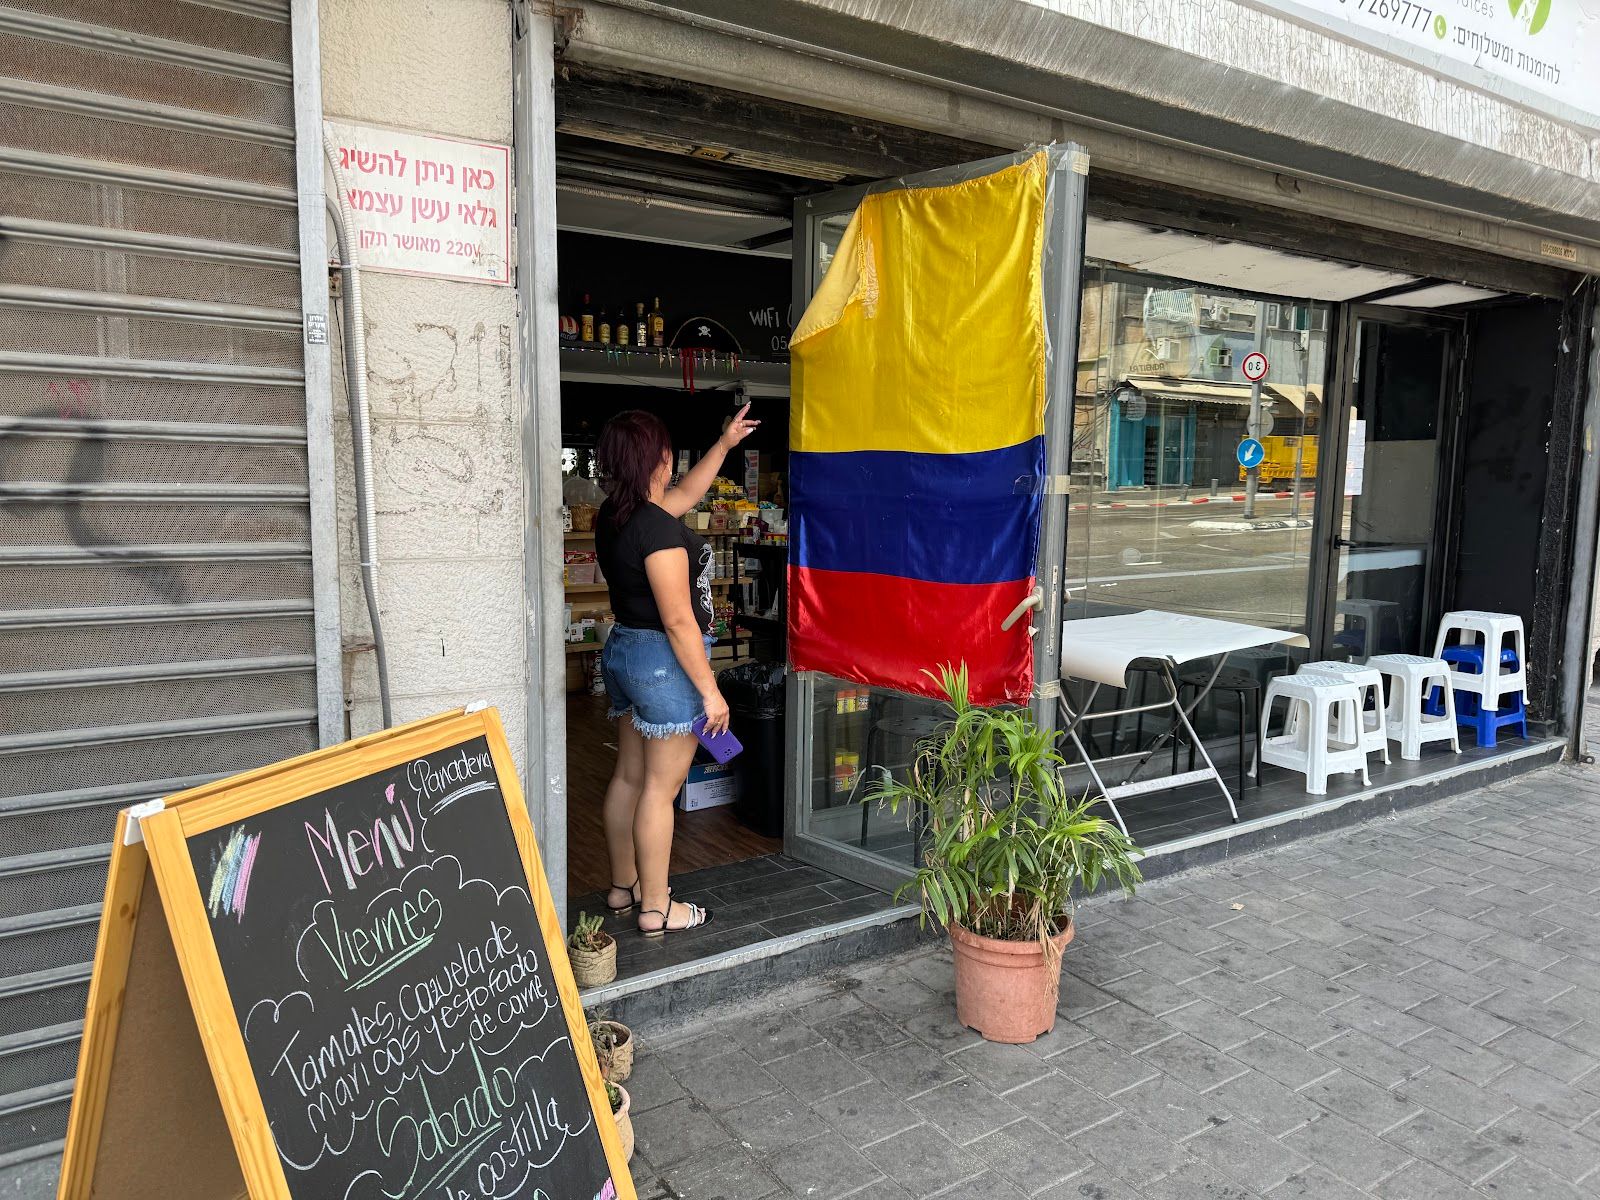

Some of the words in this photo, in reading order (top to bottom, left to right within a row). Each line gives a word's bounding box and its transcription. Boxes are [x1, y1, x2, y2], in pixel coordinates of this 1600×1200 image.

[1452, 25, 1514, 65] ומשלוחים:
[1517, 51, 1561, 85] להזמנות
[338, 147, 407, 178] להשיג
[415, 159, 455, 186] ניתן
[462, 166, 495, 193] כאן
[346, 188, 403, 217] עצמא
[411, 196, 450, 224] עשן
[457, 199, 497, 228] גלאי
[393, 233, 441, 254] מאושר
[446, 240, 482, 258] 220V
[748, 306, 780, 328] WIFI
[771, 335, 788, 351] 05
[314, 888, 443, 981] Viernes
[484, 920, 519, 964] de
[440, 949, 539, 1029] estofado
[469, 1012, 498, 1041] de
[497, 974, 548, 1024] carne
[477, 1087, 570, 1196] costilla
